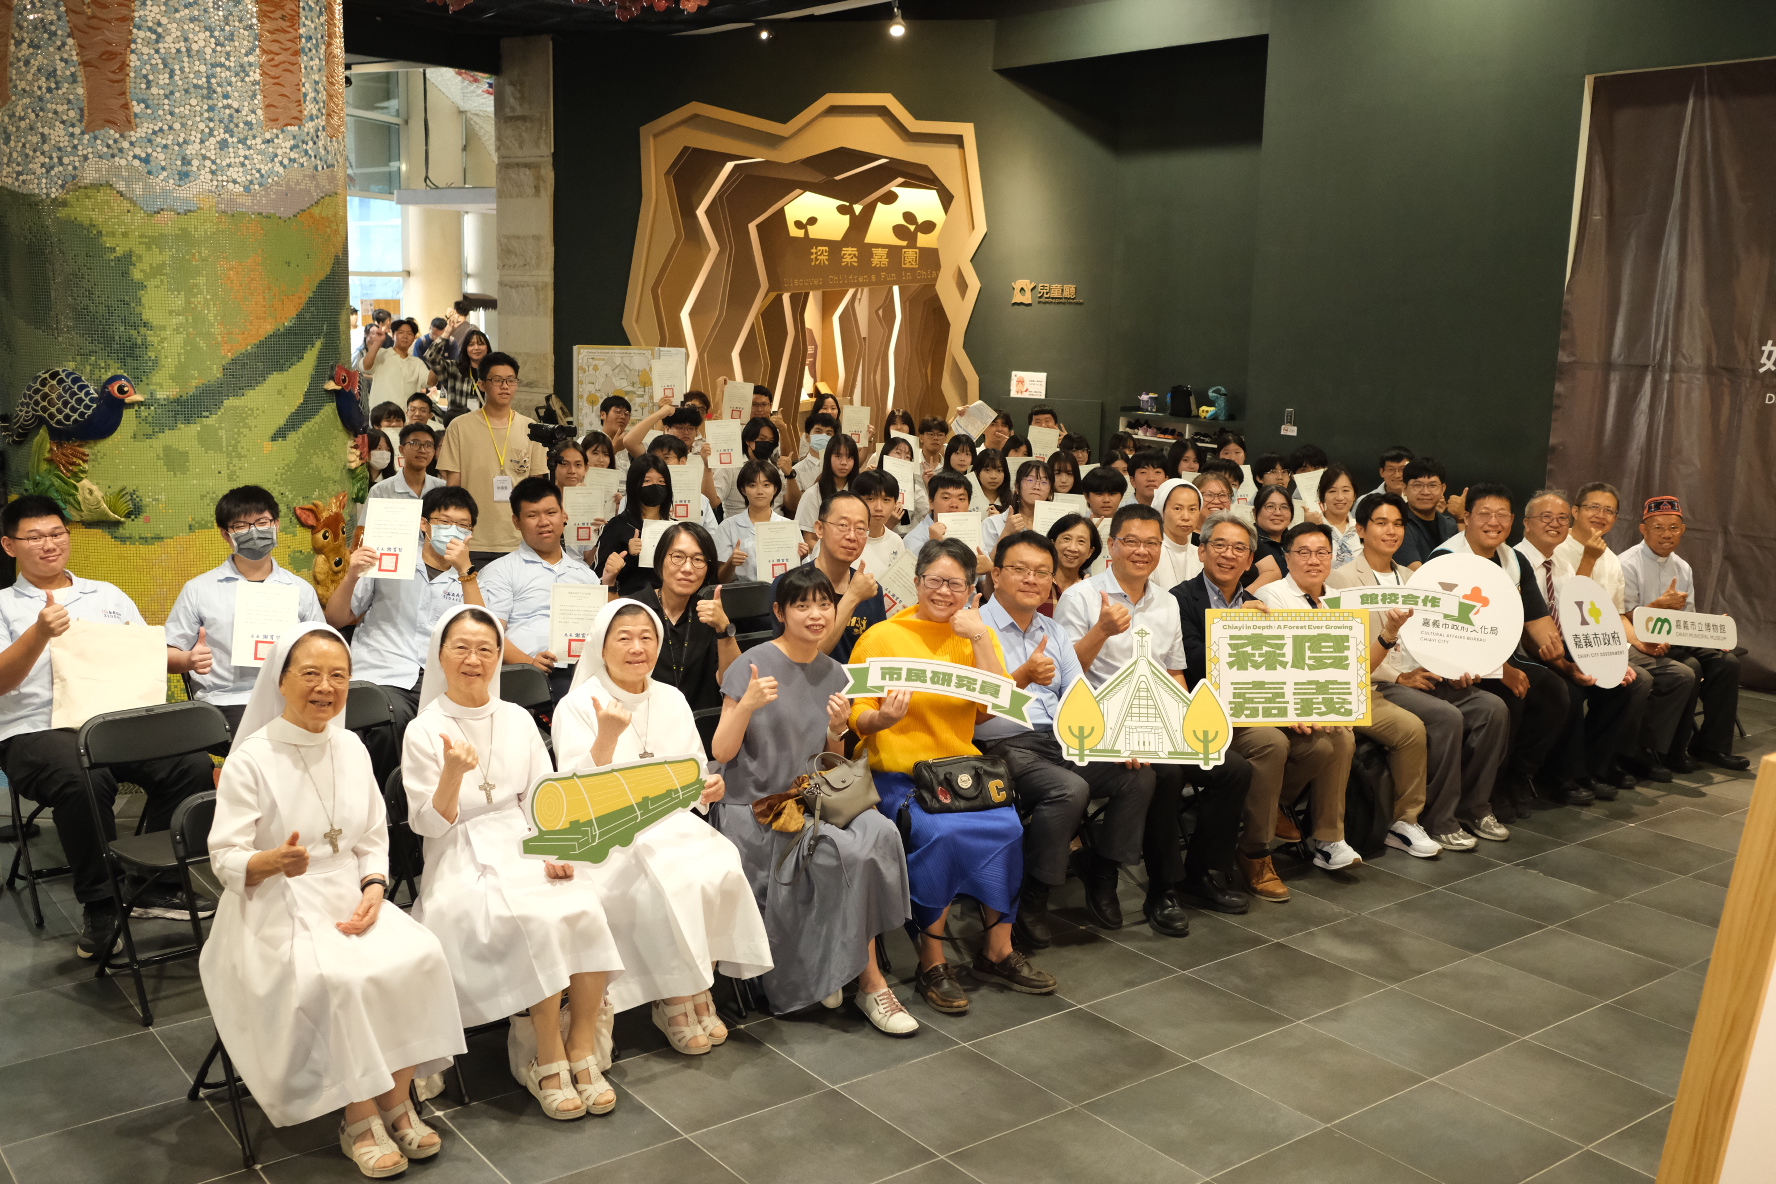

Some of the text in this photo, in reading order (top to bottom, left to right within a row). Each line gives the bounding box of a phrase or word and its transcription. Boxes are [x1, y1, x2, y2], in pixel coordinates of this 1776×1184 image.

[811, 246, 919, 268] 探索嘉園
[783, 277, 823, 287] Discover
[881, 272, 896, 281] Fun
[901, 271, 912, 280] in
[916, 269, 939, 279] Chia
[1037, 284, 1077, 299] 兒童廳
[1359, 592, 1441, 608] 館校合作
[1222, 624, 1244, 632] Chiayi
[1325, 624, 1353, 632] Growing
[1675, 619, 1727, 634] 嘉義市立博物館
[1572, 630, 1621, 649] 嘉義市政府
[1226, 633, 1351, 671] 森度
[879, 666, 1001, 699] 市民研究員
[1228, 680, 1354, 719] 嘉義
[988, 779, 1007, 803] C
